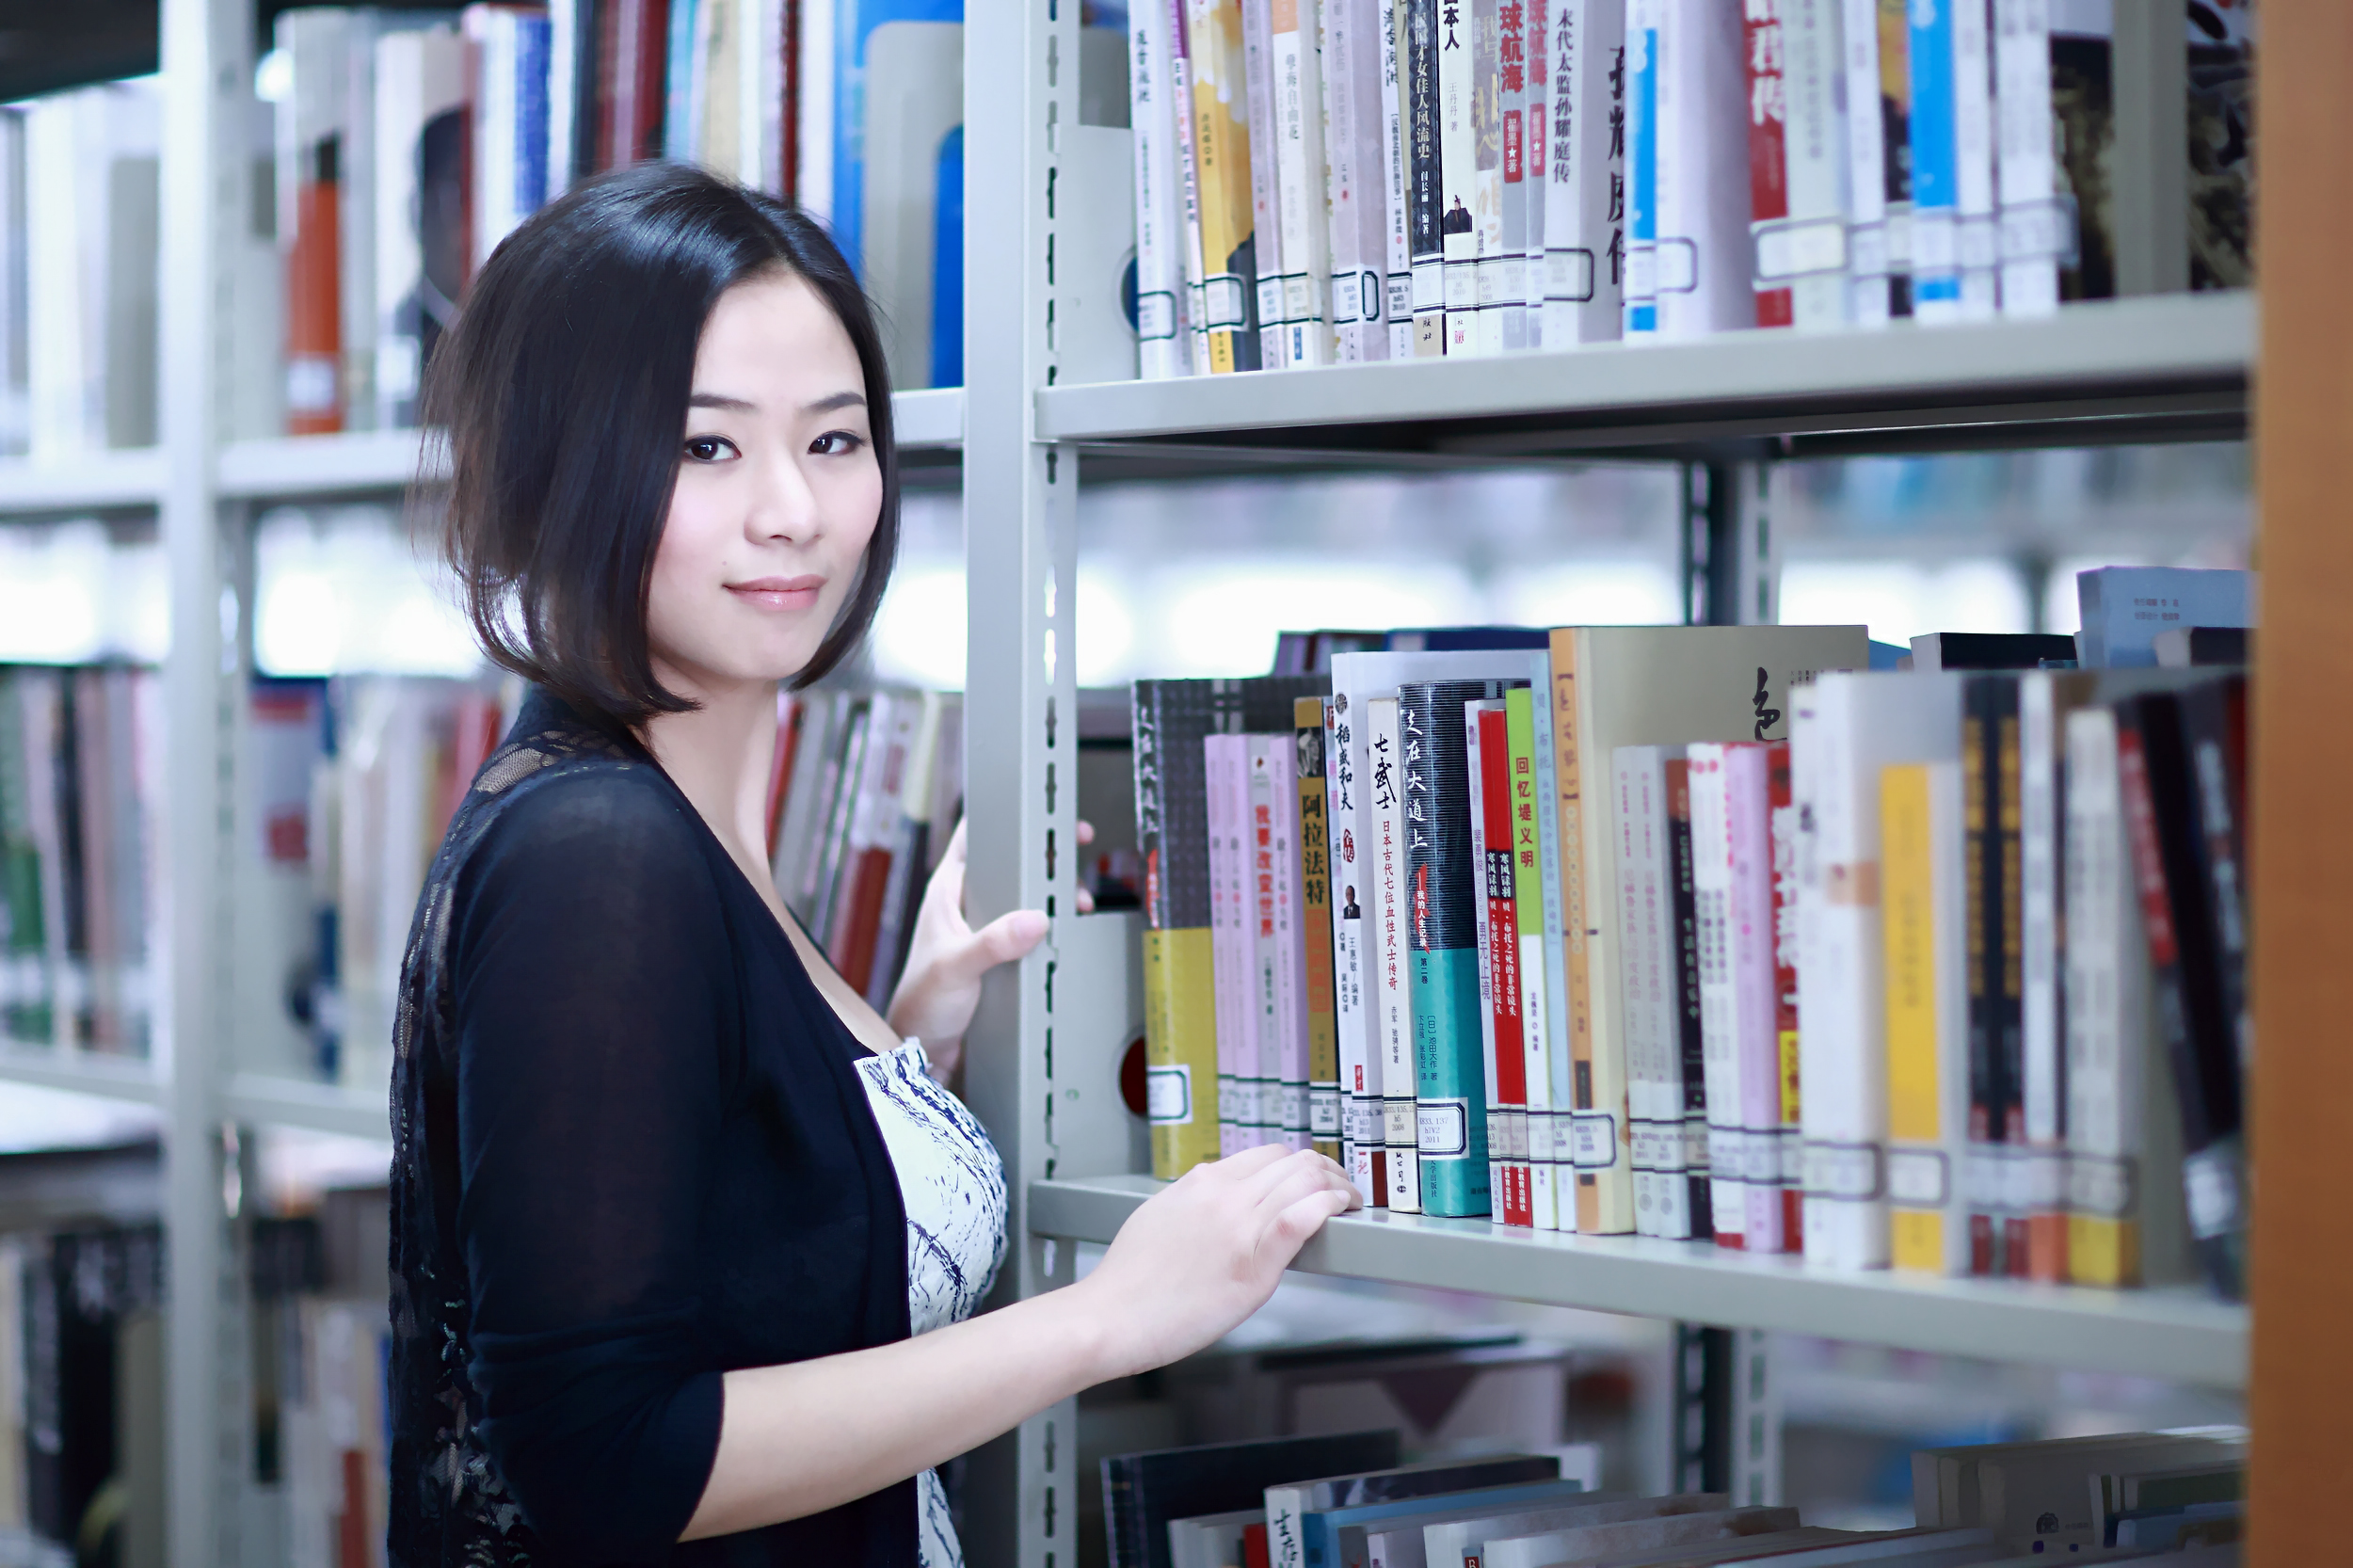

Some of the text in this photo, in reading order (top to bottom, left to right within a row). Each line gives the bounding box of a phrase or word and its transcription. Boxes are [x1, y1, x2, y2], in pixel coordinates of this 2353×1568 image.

[1443, 0, 1460, 52] 本人
[1450, 120, 1459, 133] 著
[1553, 8, 1574, 184] 末代太监孙耀庭传
[1335, 723, 1353, 811] 稻盛和夫
[1374, 733, 1397, 809] 七武士
[1406, 709, 1428, 849] 走在大道上
[1515, 757, 1534, 868] 回忆堤义明
[1302, 793, 1325, 904] 阿拉法特
[1382, 820, 1399, 990] 日本古代七位血性武士传奇
[1478, 920, 1491, 1000] 勇无止境
